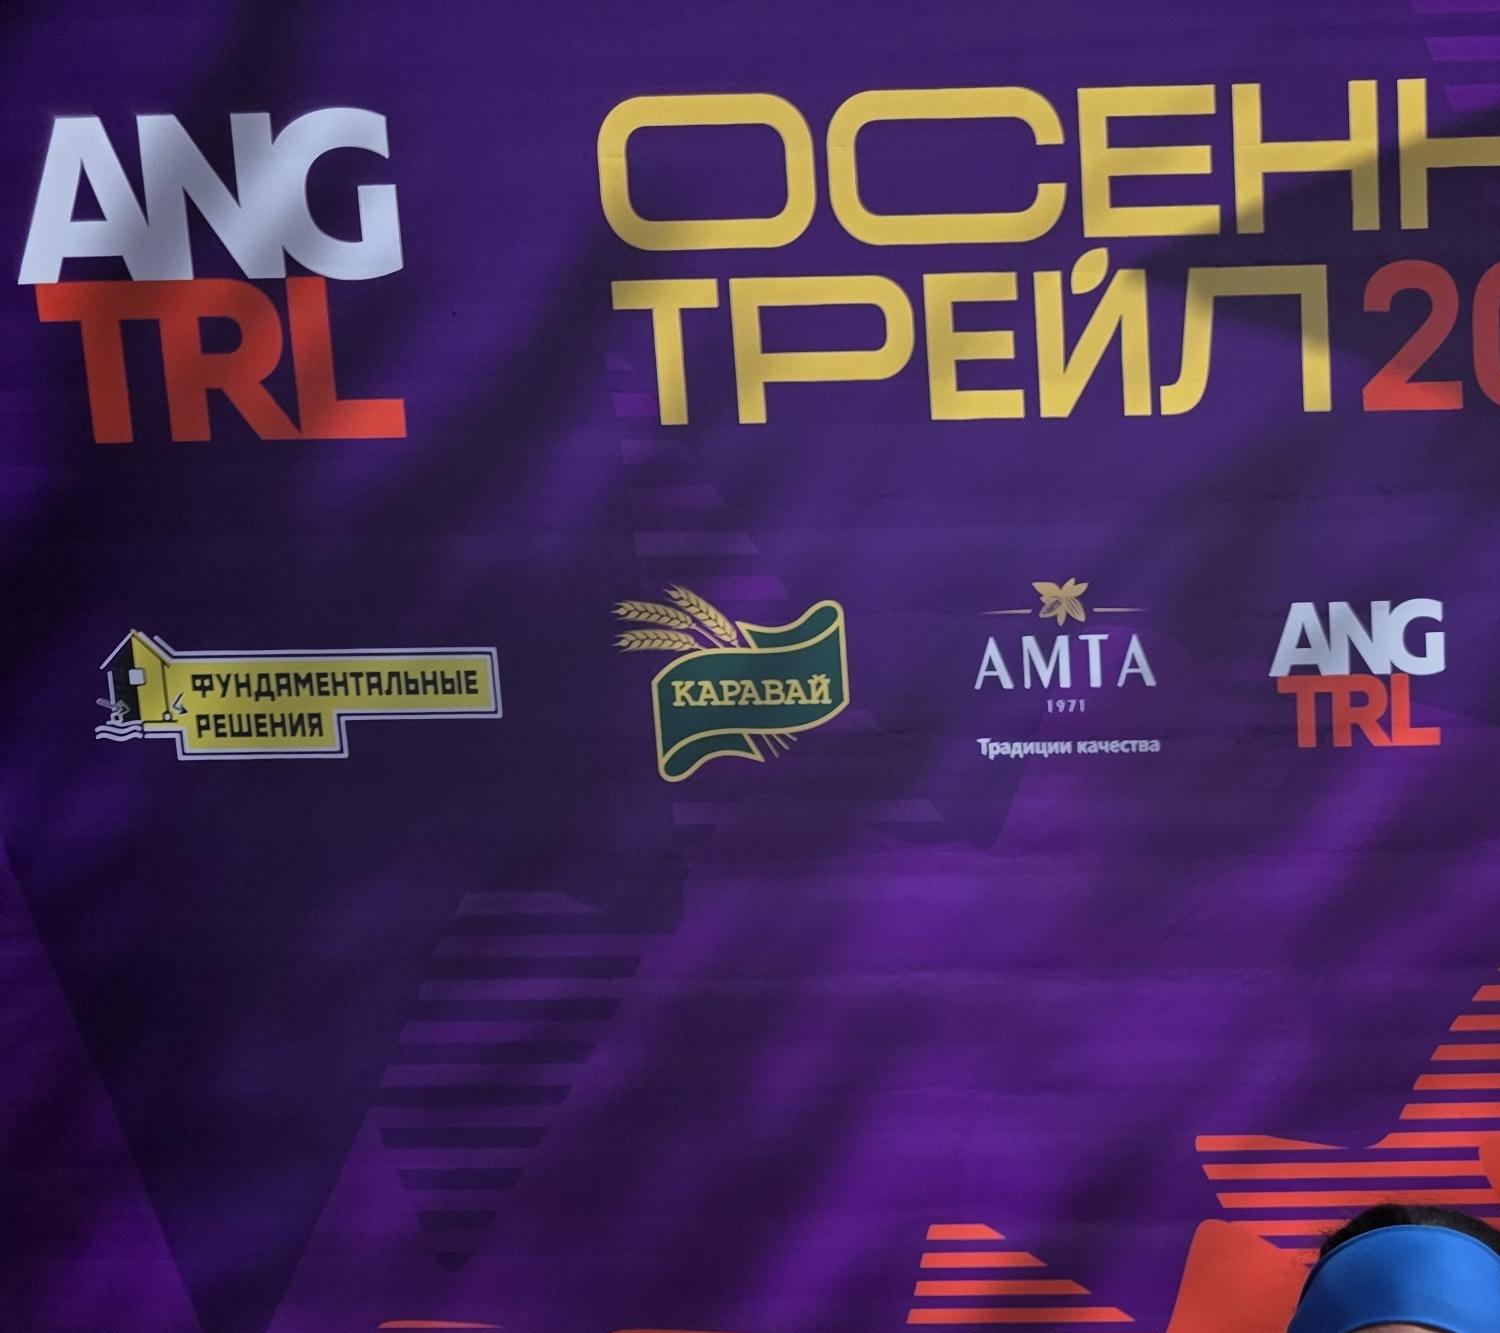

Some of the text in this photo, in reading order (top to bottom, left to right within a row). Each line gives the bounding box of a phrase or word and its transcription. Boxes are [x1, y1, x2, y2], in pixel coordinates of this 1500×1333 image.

[18, 107, 403, 285] ANG
[36, 276, 406, 444] TRL
[611, 248, 1332, 425] ТРЕЙЛ
[974, 633, 1157, 690] АМТА
[1268, 598, 1446, 677] ANG
[191, 670, 479, 702] ФУНДАМЕНТАЛЬНЫЕ
[671, 674, 832, 706] КАРАВАЙ
[1046, 699, 1086, 713] 1971
[1277, 672, 1441, 748] TRL
[196, 712, 324, 738] РЕШЕНИЯ
[976, 738, 1161, 760] Традиции качества
